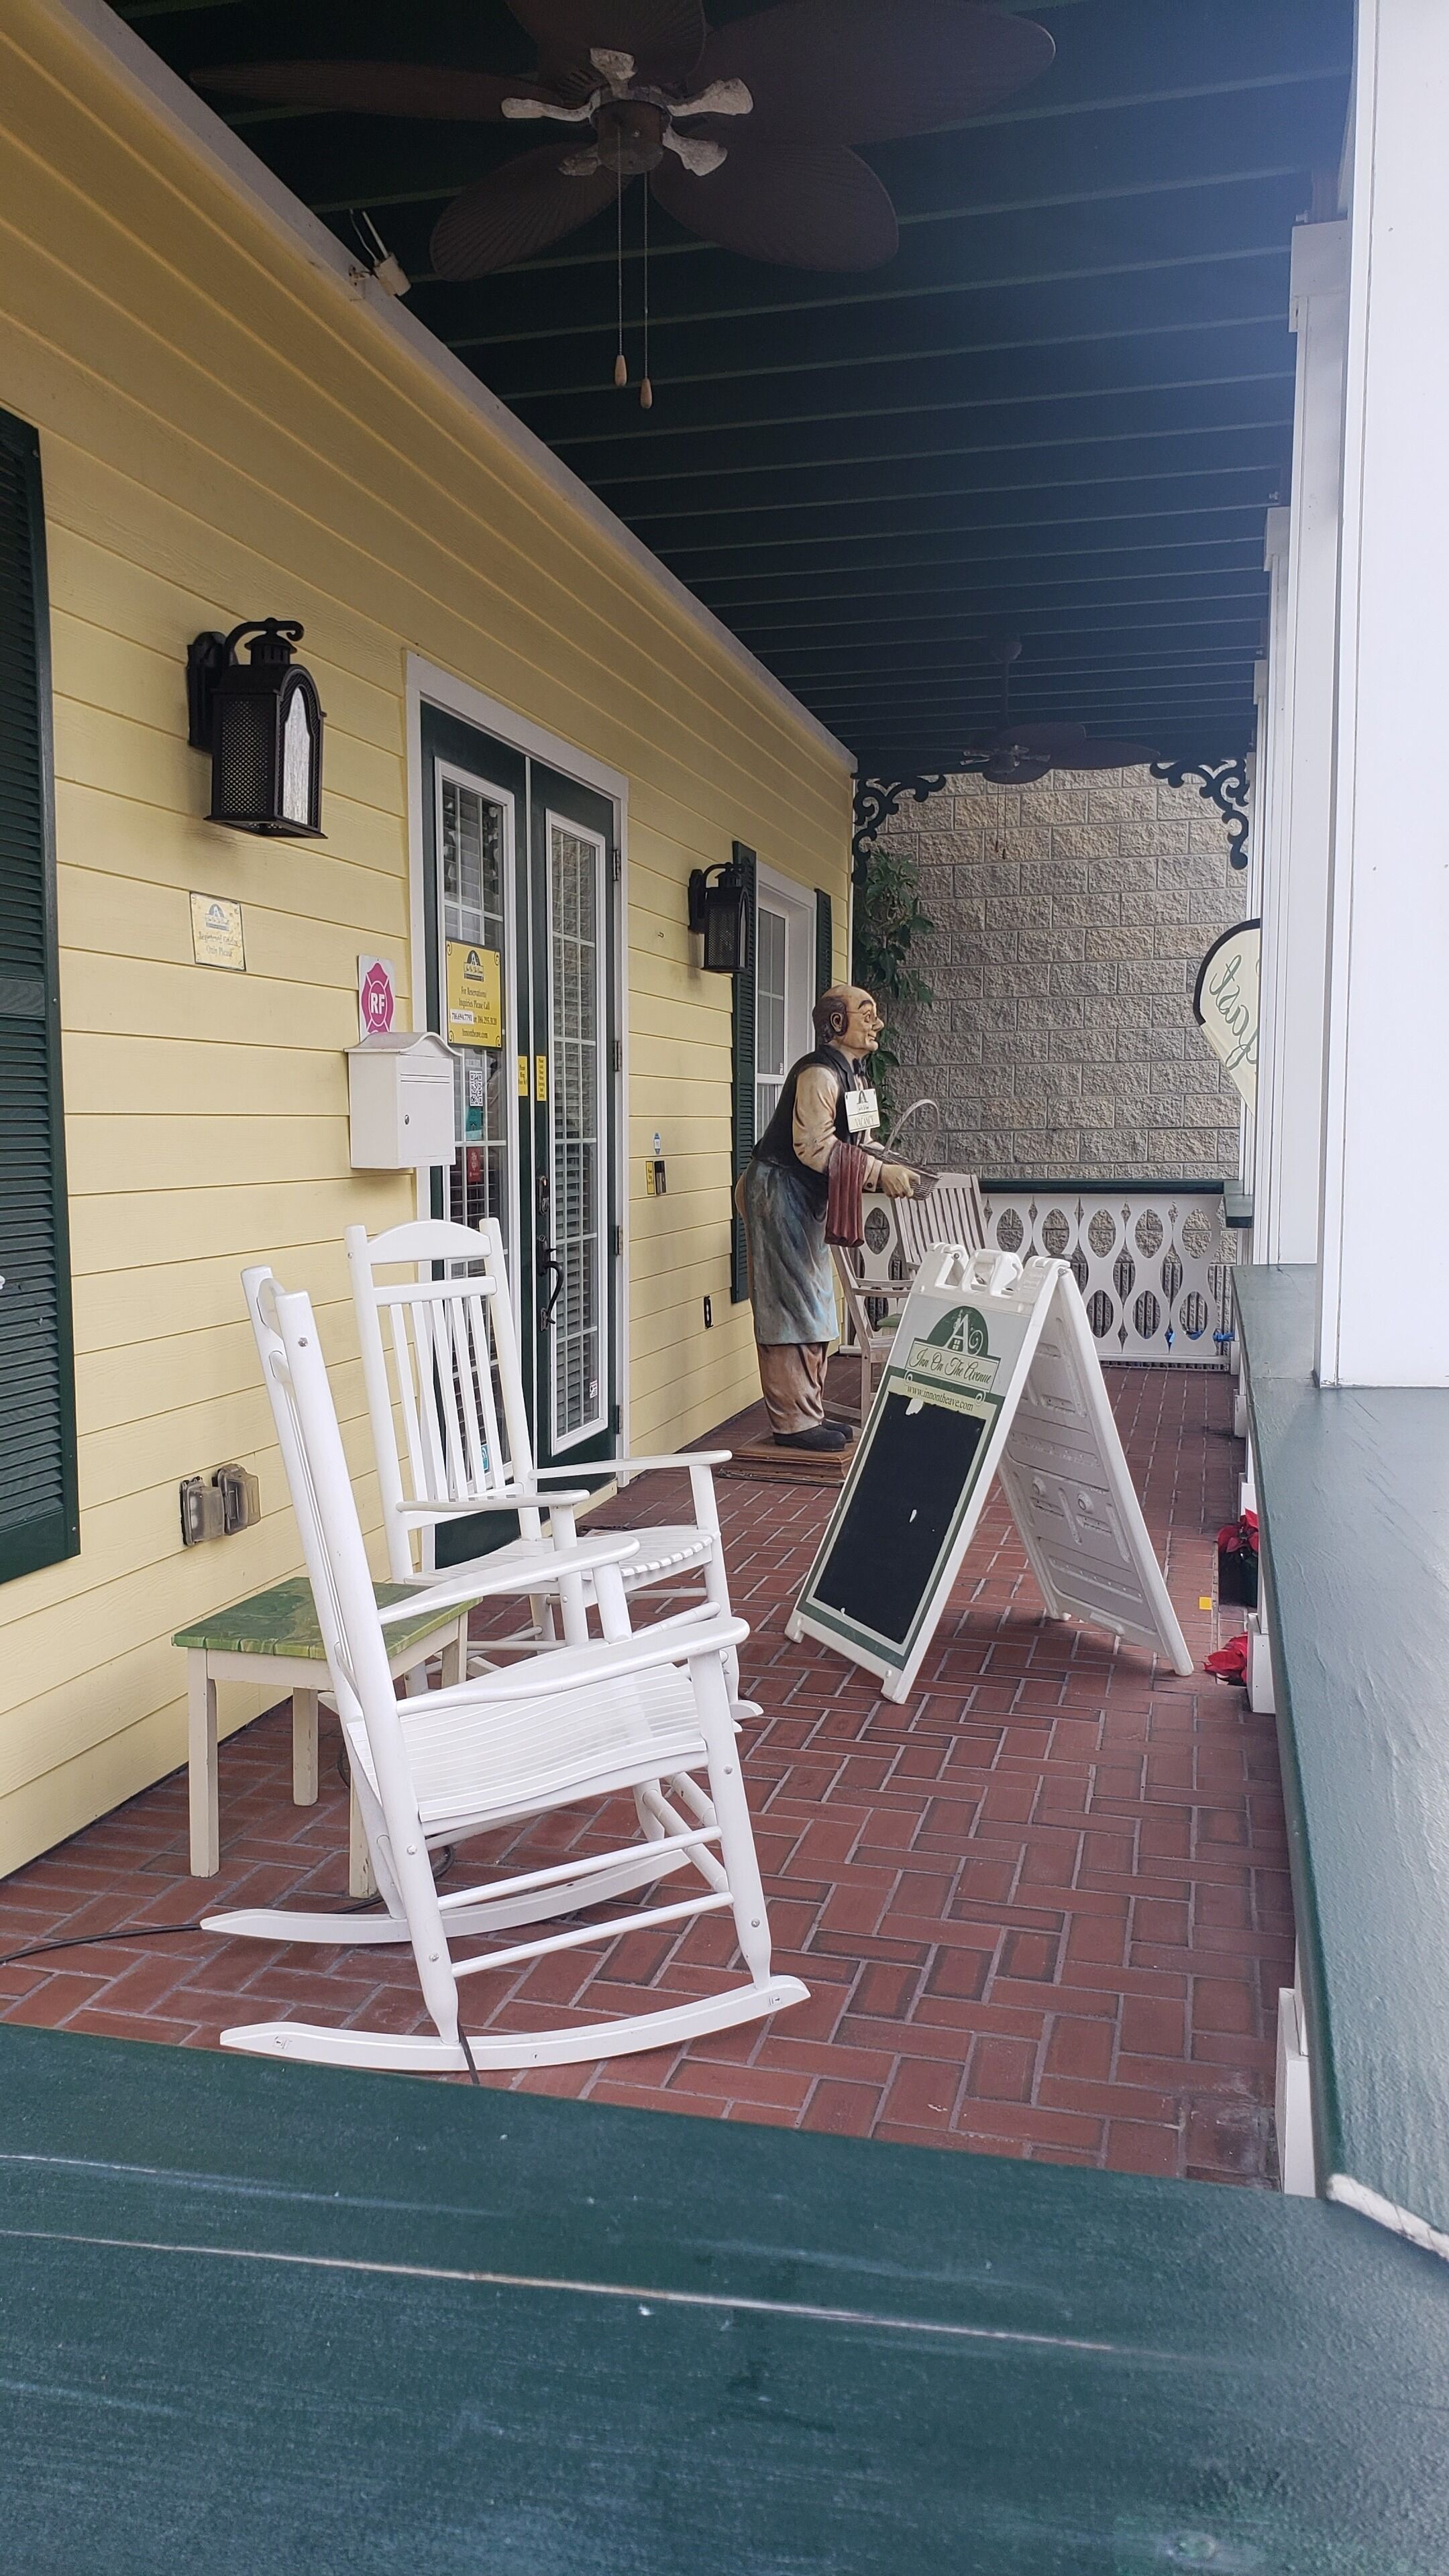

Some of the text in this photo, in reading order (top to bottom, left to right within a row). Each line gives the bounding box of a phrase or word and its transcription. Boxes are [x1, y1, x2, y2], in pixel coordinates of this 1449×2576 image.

[370, 992, 385, 1015] RF
[909, 1348, 992, 1385] Inn On The Avenue
[907, 1385, 974, 1411] www.innontheave.com
